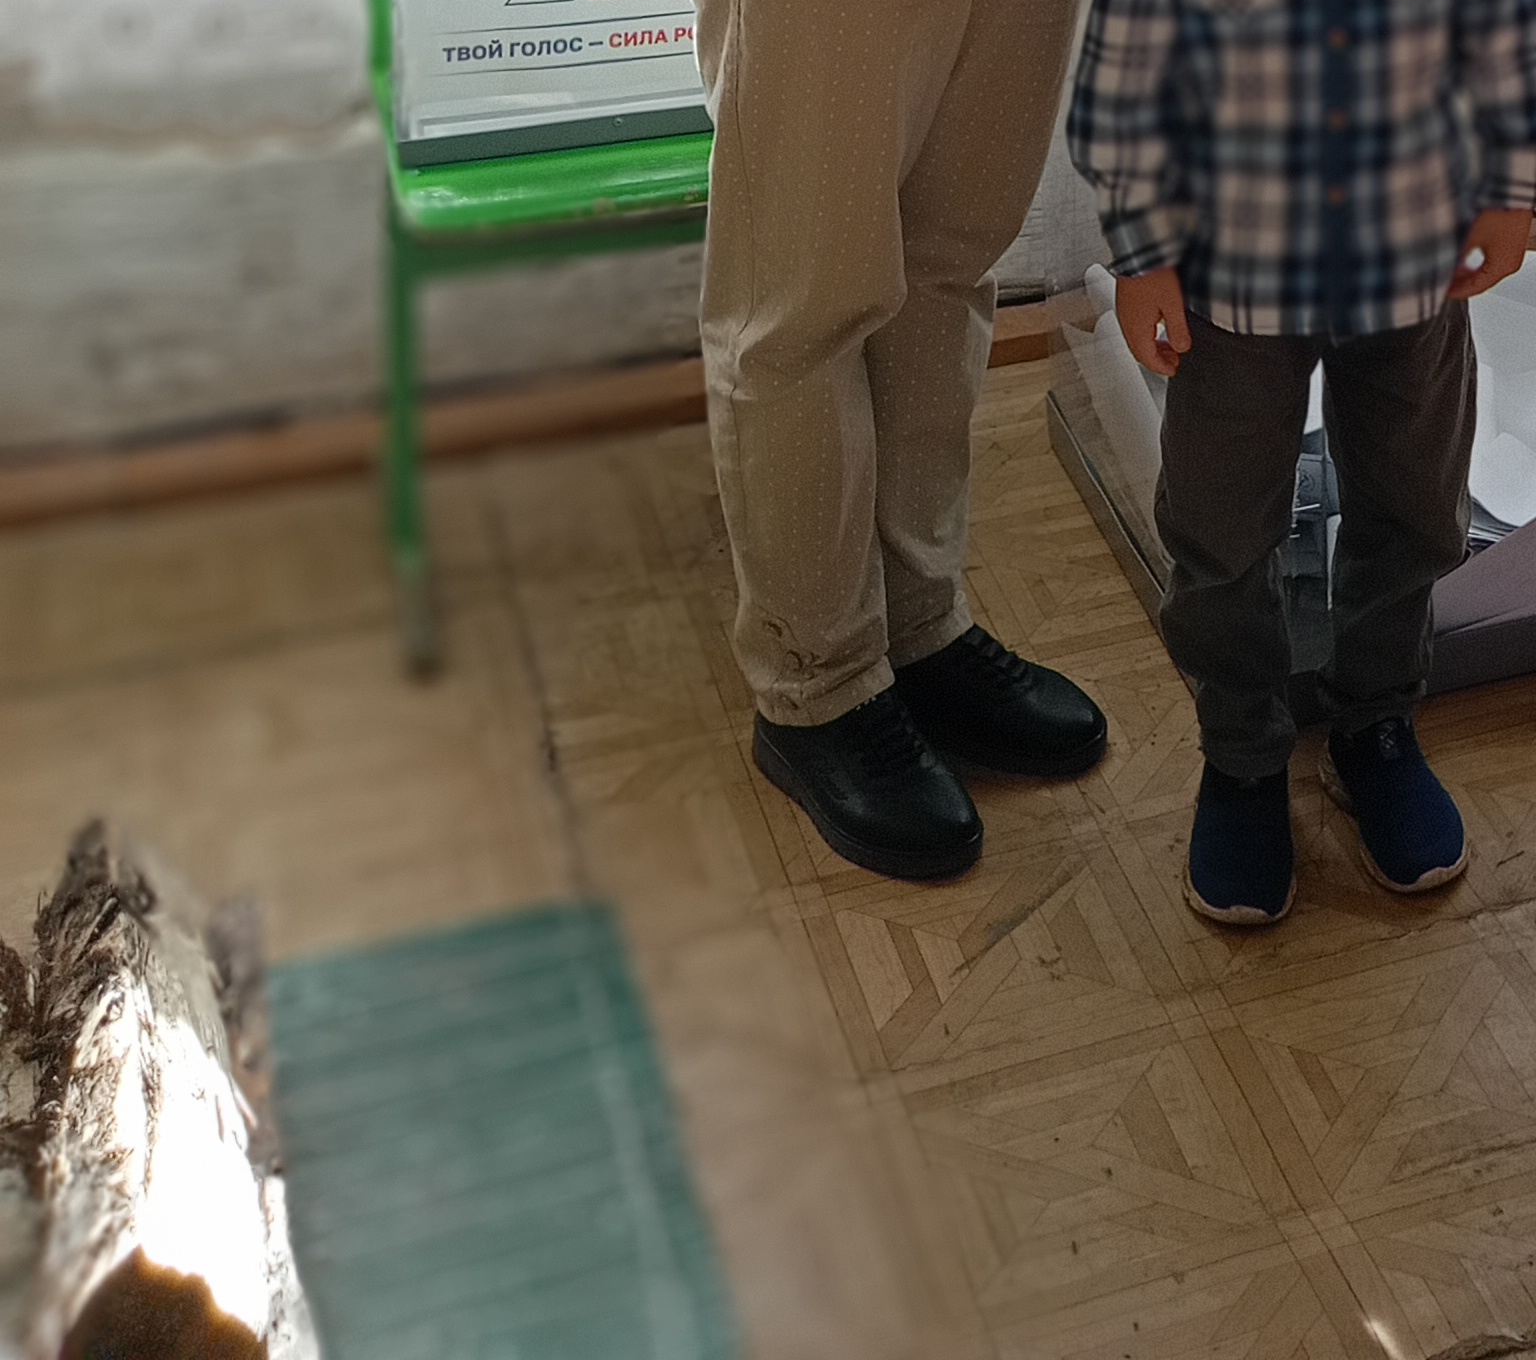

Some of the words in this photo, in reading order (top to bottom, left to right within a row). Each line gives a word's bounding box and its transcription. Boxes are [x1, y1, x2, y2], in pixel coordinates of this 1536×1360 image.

[443, 40, 503, 63] ТВОЙ
[509, 37, 583, 59] ГОЛОС
[609, 30, 668, 49] СИЛА
